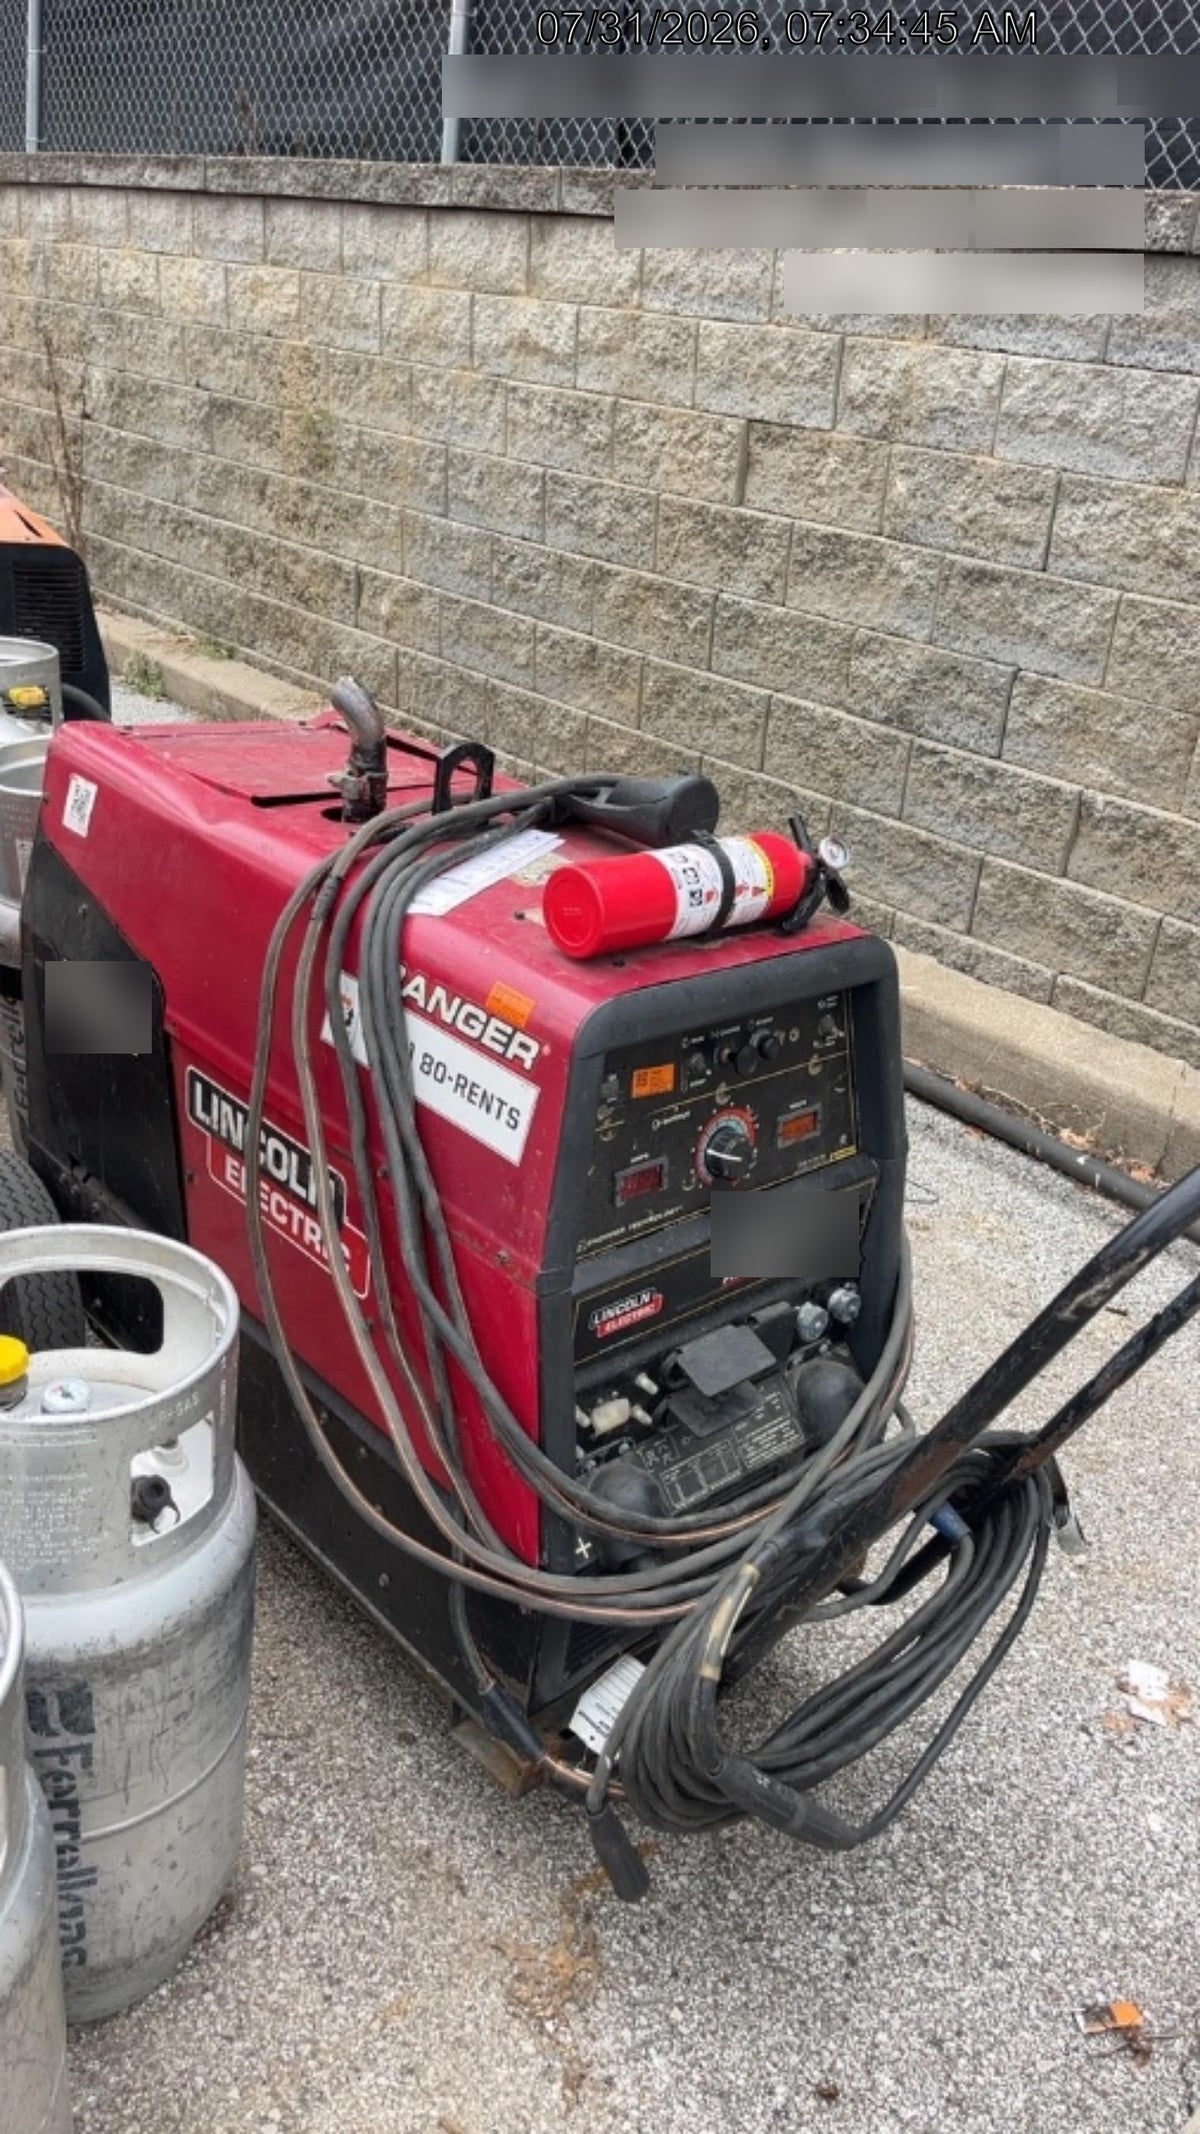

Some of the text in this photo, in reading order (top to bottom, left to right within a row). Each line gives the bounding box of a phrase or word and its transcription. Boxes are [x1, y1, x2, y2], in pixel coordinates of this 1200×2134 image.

[400, 965, 541, 1070] ANGER
[419, 1052, 522, 1131] 80-RENTS
[225, 1154, 351, 1271] ELECTR
